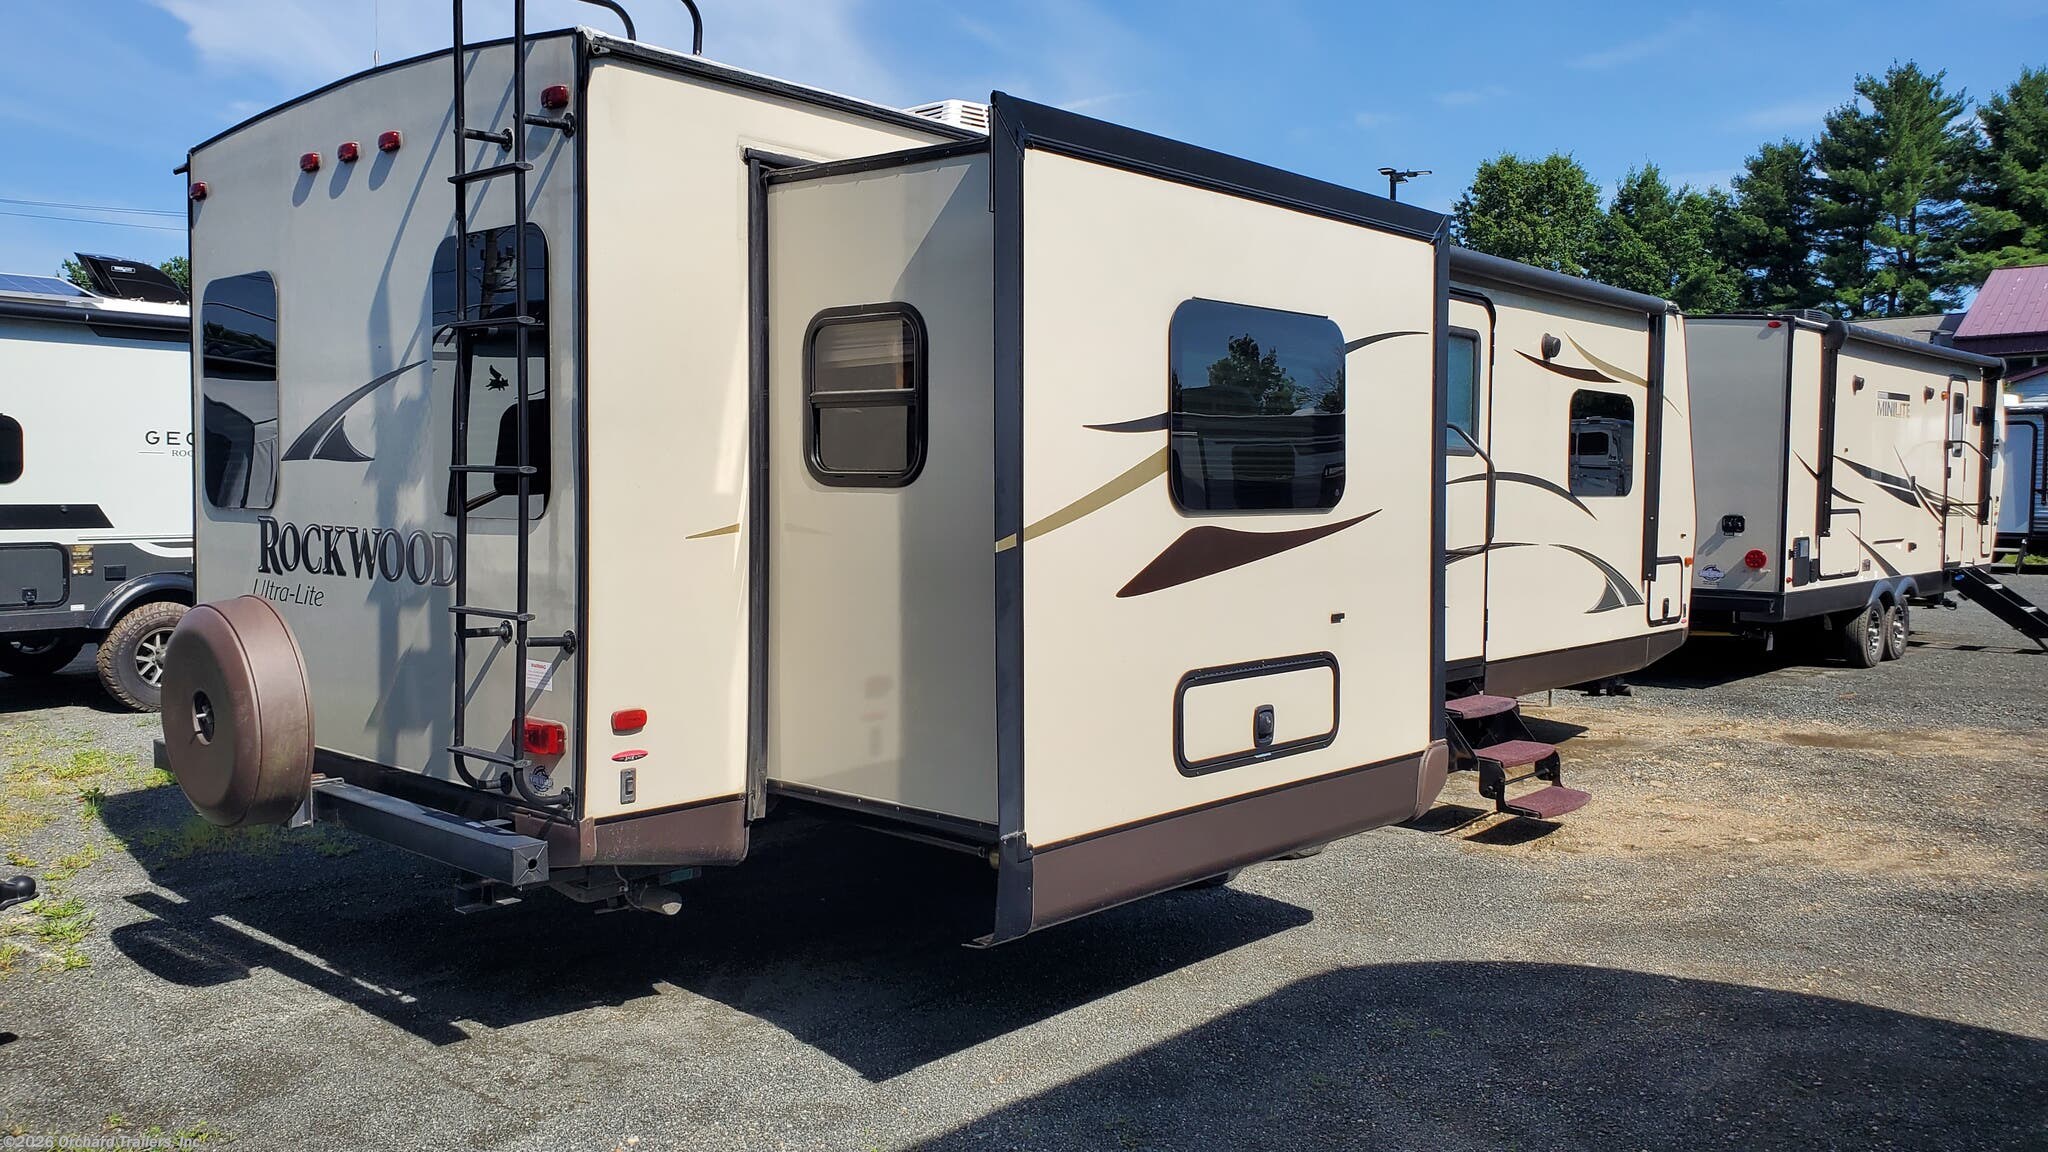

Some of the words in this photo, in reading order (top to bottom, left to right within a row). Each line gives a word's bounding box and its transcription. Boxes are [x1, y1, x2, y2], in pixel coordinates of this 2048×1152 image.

[1876, 400, 1910, 418] MINILITE
[257, 516, 457, 587] ROCKWOOD
[252, 579, 324, 607] Ultra-Lite
